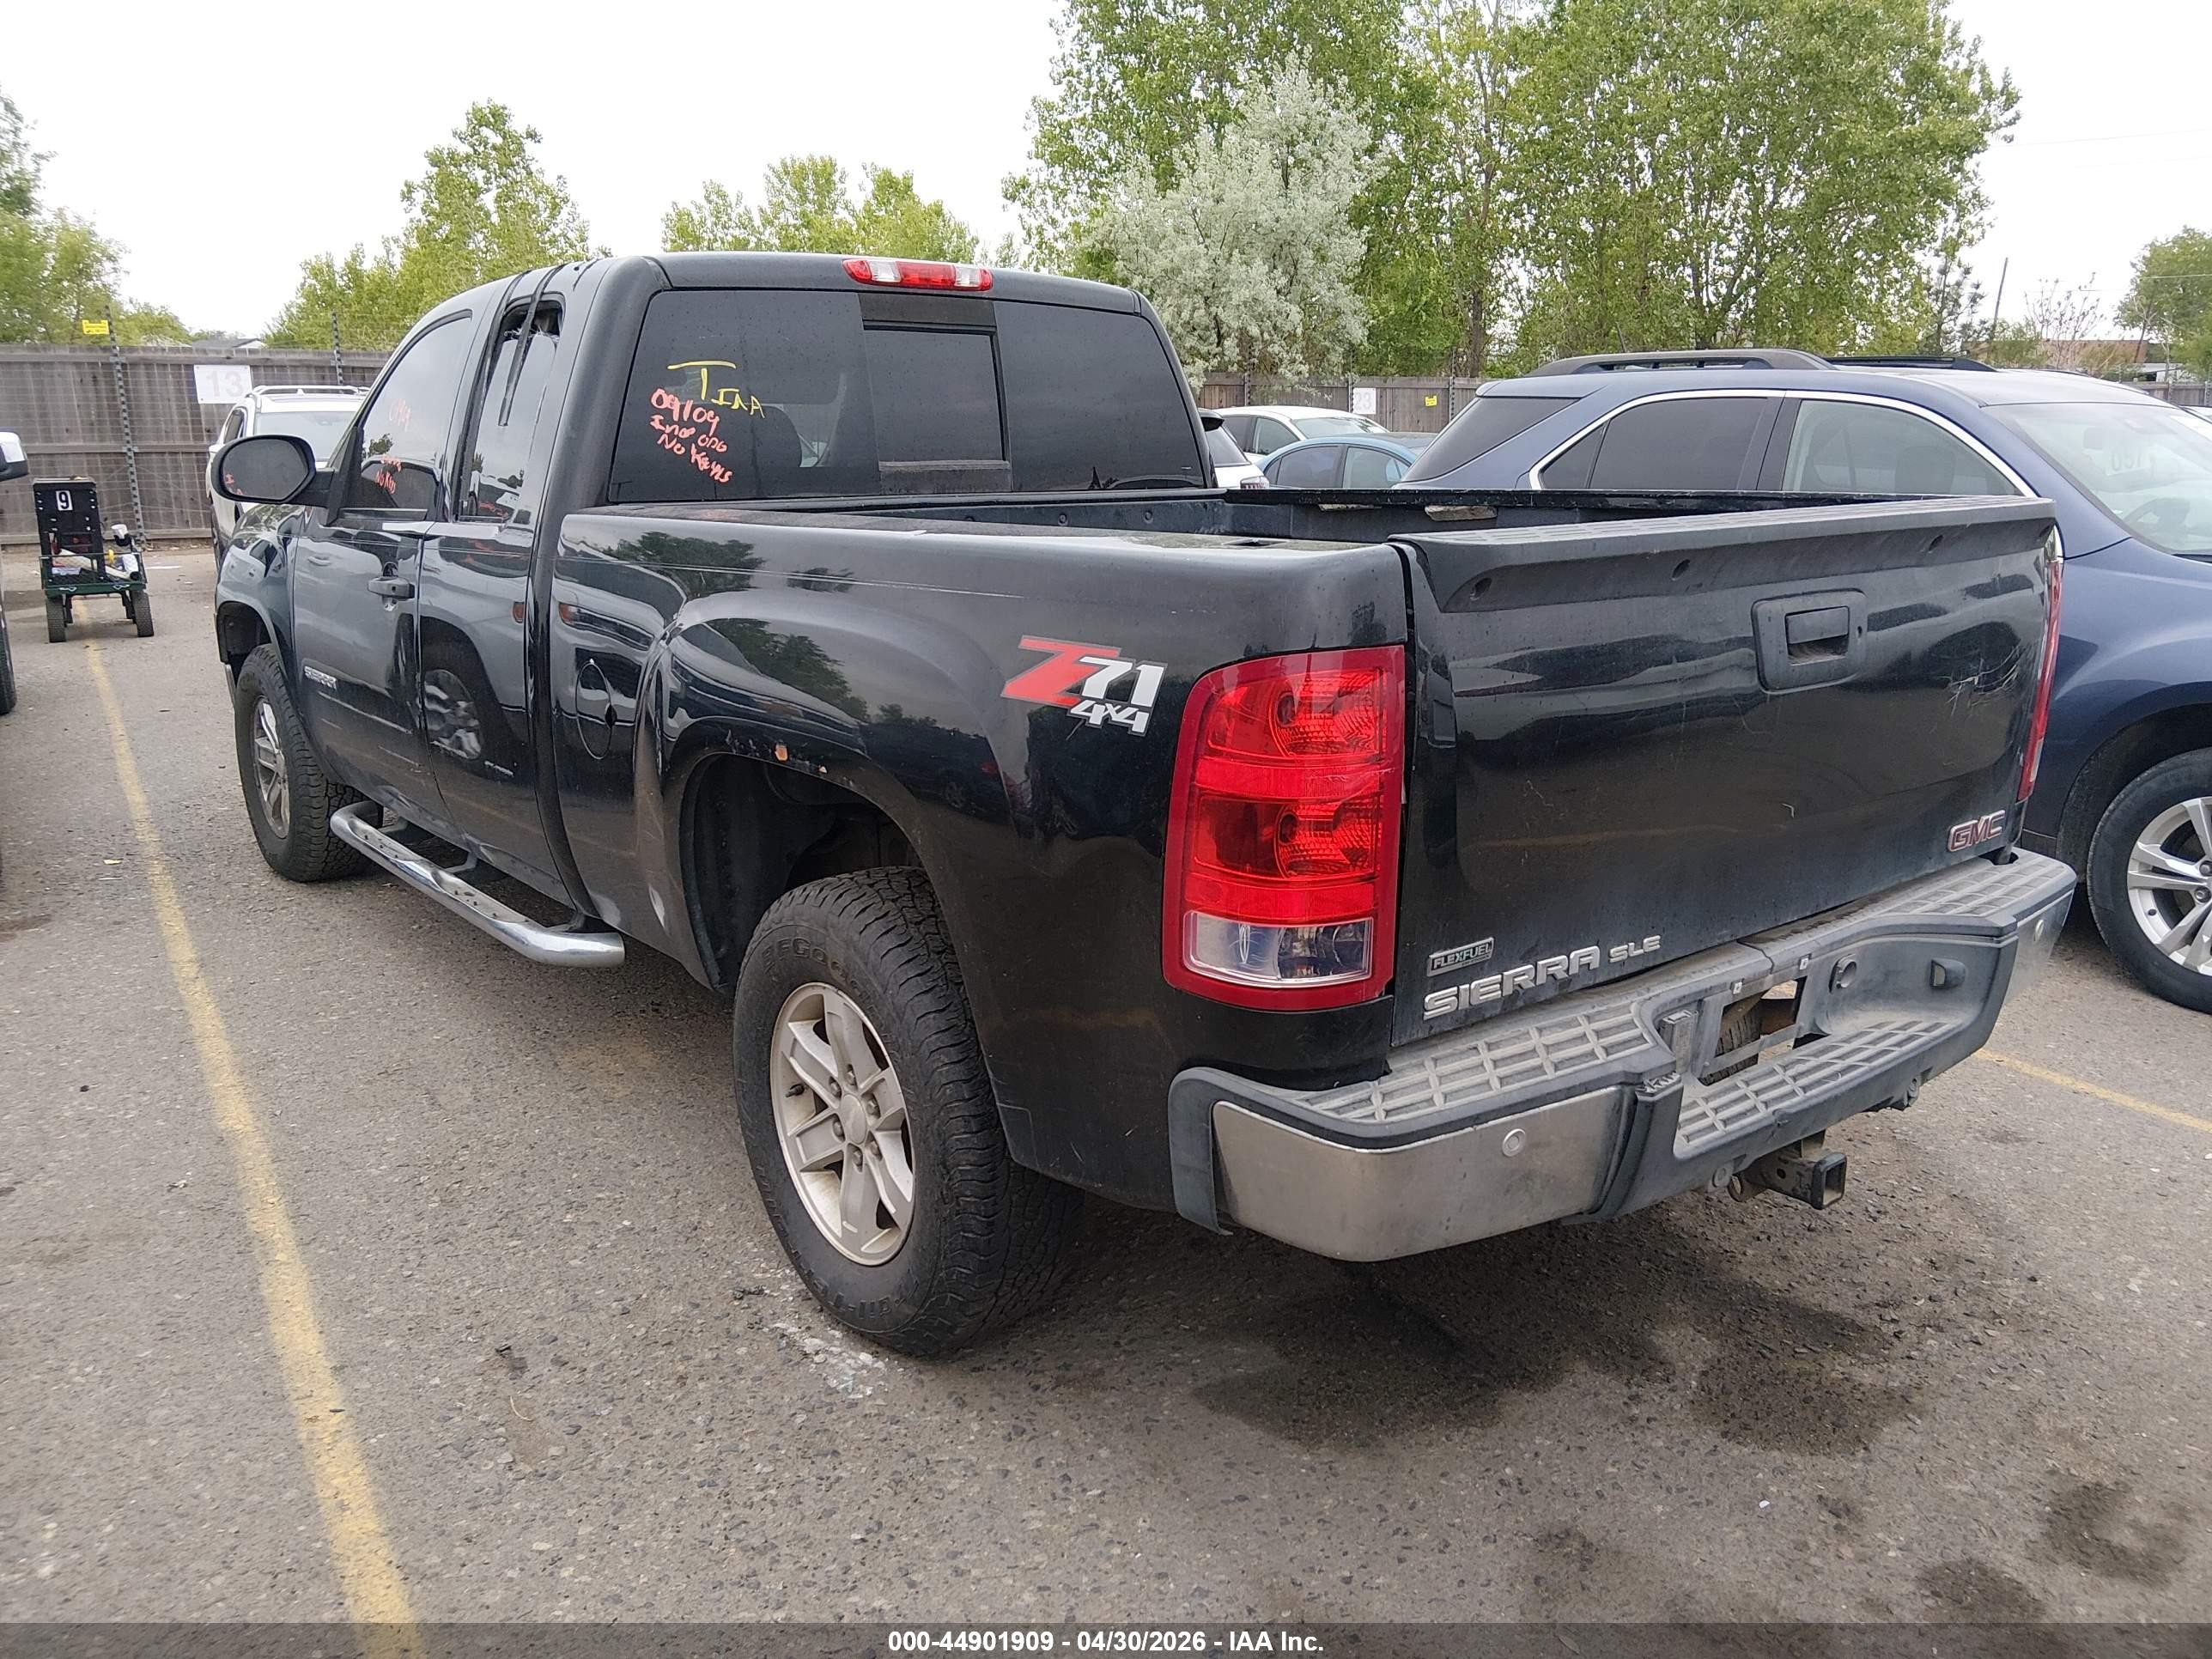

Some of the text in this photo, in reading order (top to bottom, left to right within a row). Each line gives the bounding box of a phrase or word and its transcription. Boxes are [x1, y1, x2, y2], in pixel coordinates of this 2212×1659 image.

[206, 370, 244, 397] 13
[58, 492, 70, 509] 9
[1001, 635, 1166, 708] Z71
[1948, 810, 2005, 852] GMC
[1433, 942, 1492, 969] FLEXFUEL
[1423, 935, 1661, 1020] SIERRA SLE
